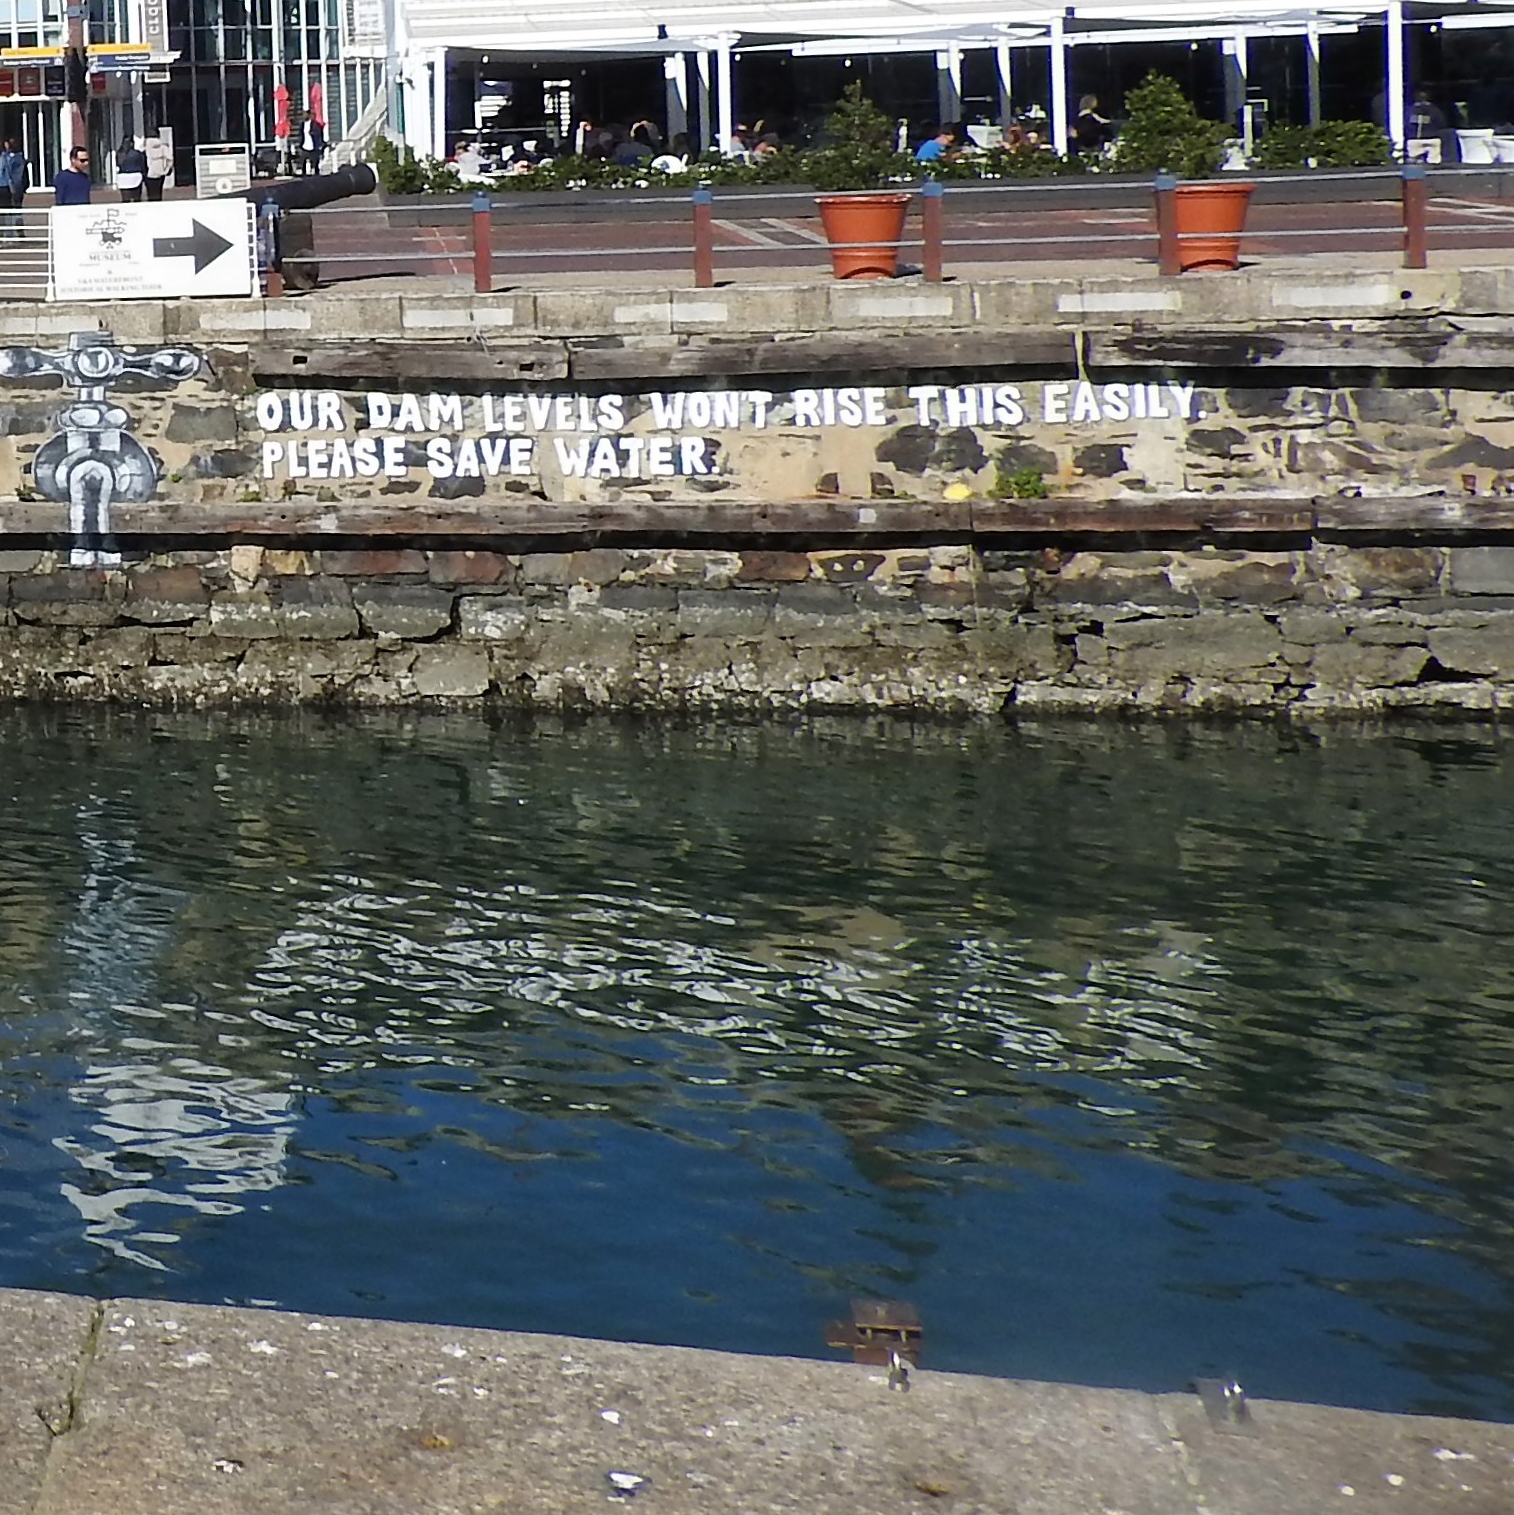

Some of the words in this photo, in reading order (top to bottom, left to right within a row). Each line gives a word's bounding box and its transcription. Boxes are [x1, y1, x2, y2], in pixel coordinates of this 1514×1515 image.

[89, 253, 131, 262] MUSEUM
[256, 390, 345, 432] OUR
[366, 391, 464, 433] DAM
[481, 392, 626, 434] LEVELS
[649, 390, 774, 430] WON'T
[792, 386, 888, 428] RISE
[907, 384, 1025, 428] THIS
[1042, 379, 1208, 424] EASILY.
[261, 436, 409, 480] PLEASE
[426, 436, 535, 480] SAVE
[553, 435, 721, 479] WATER.
